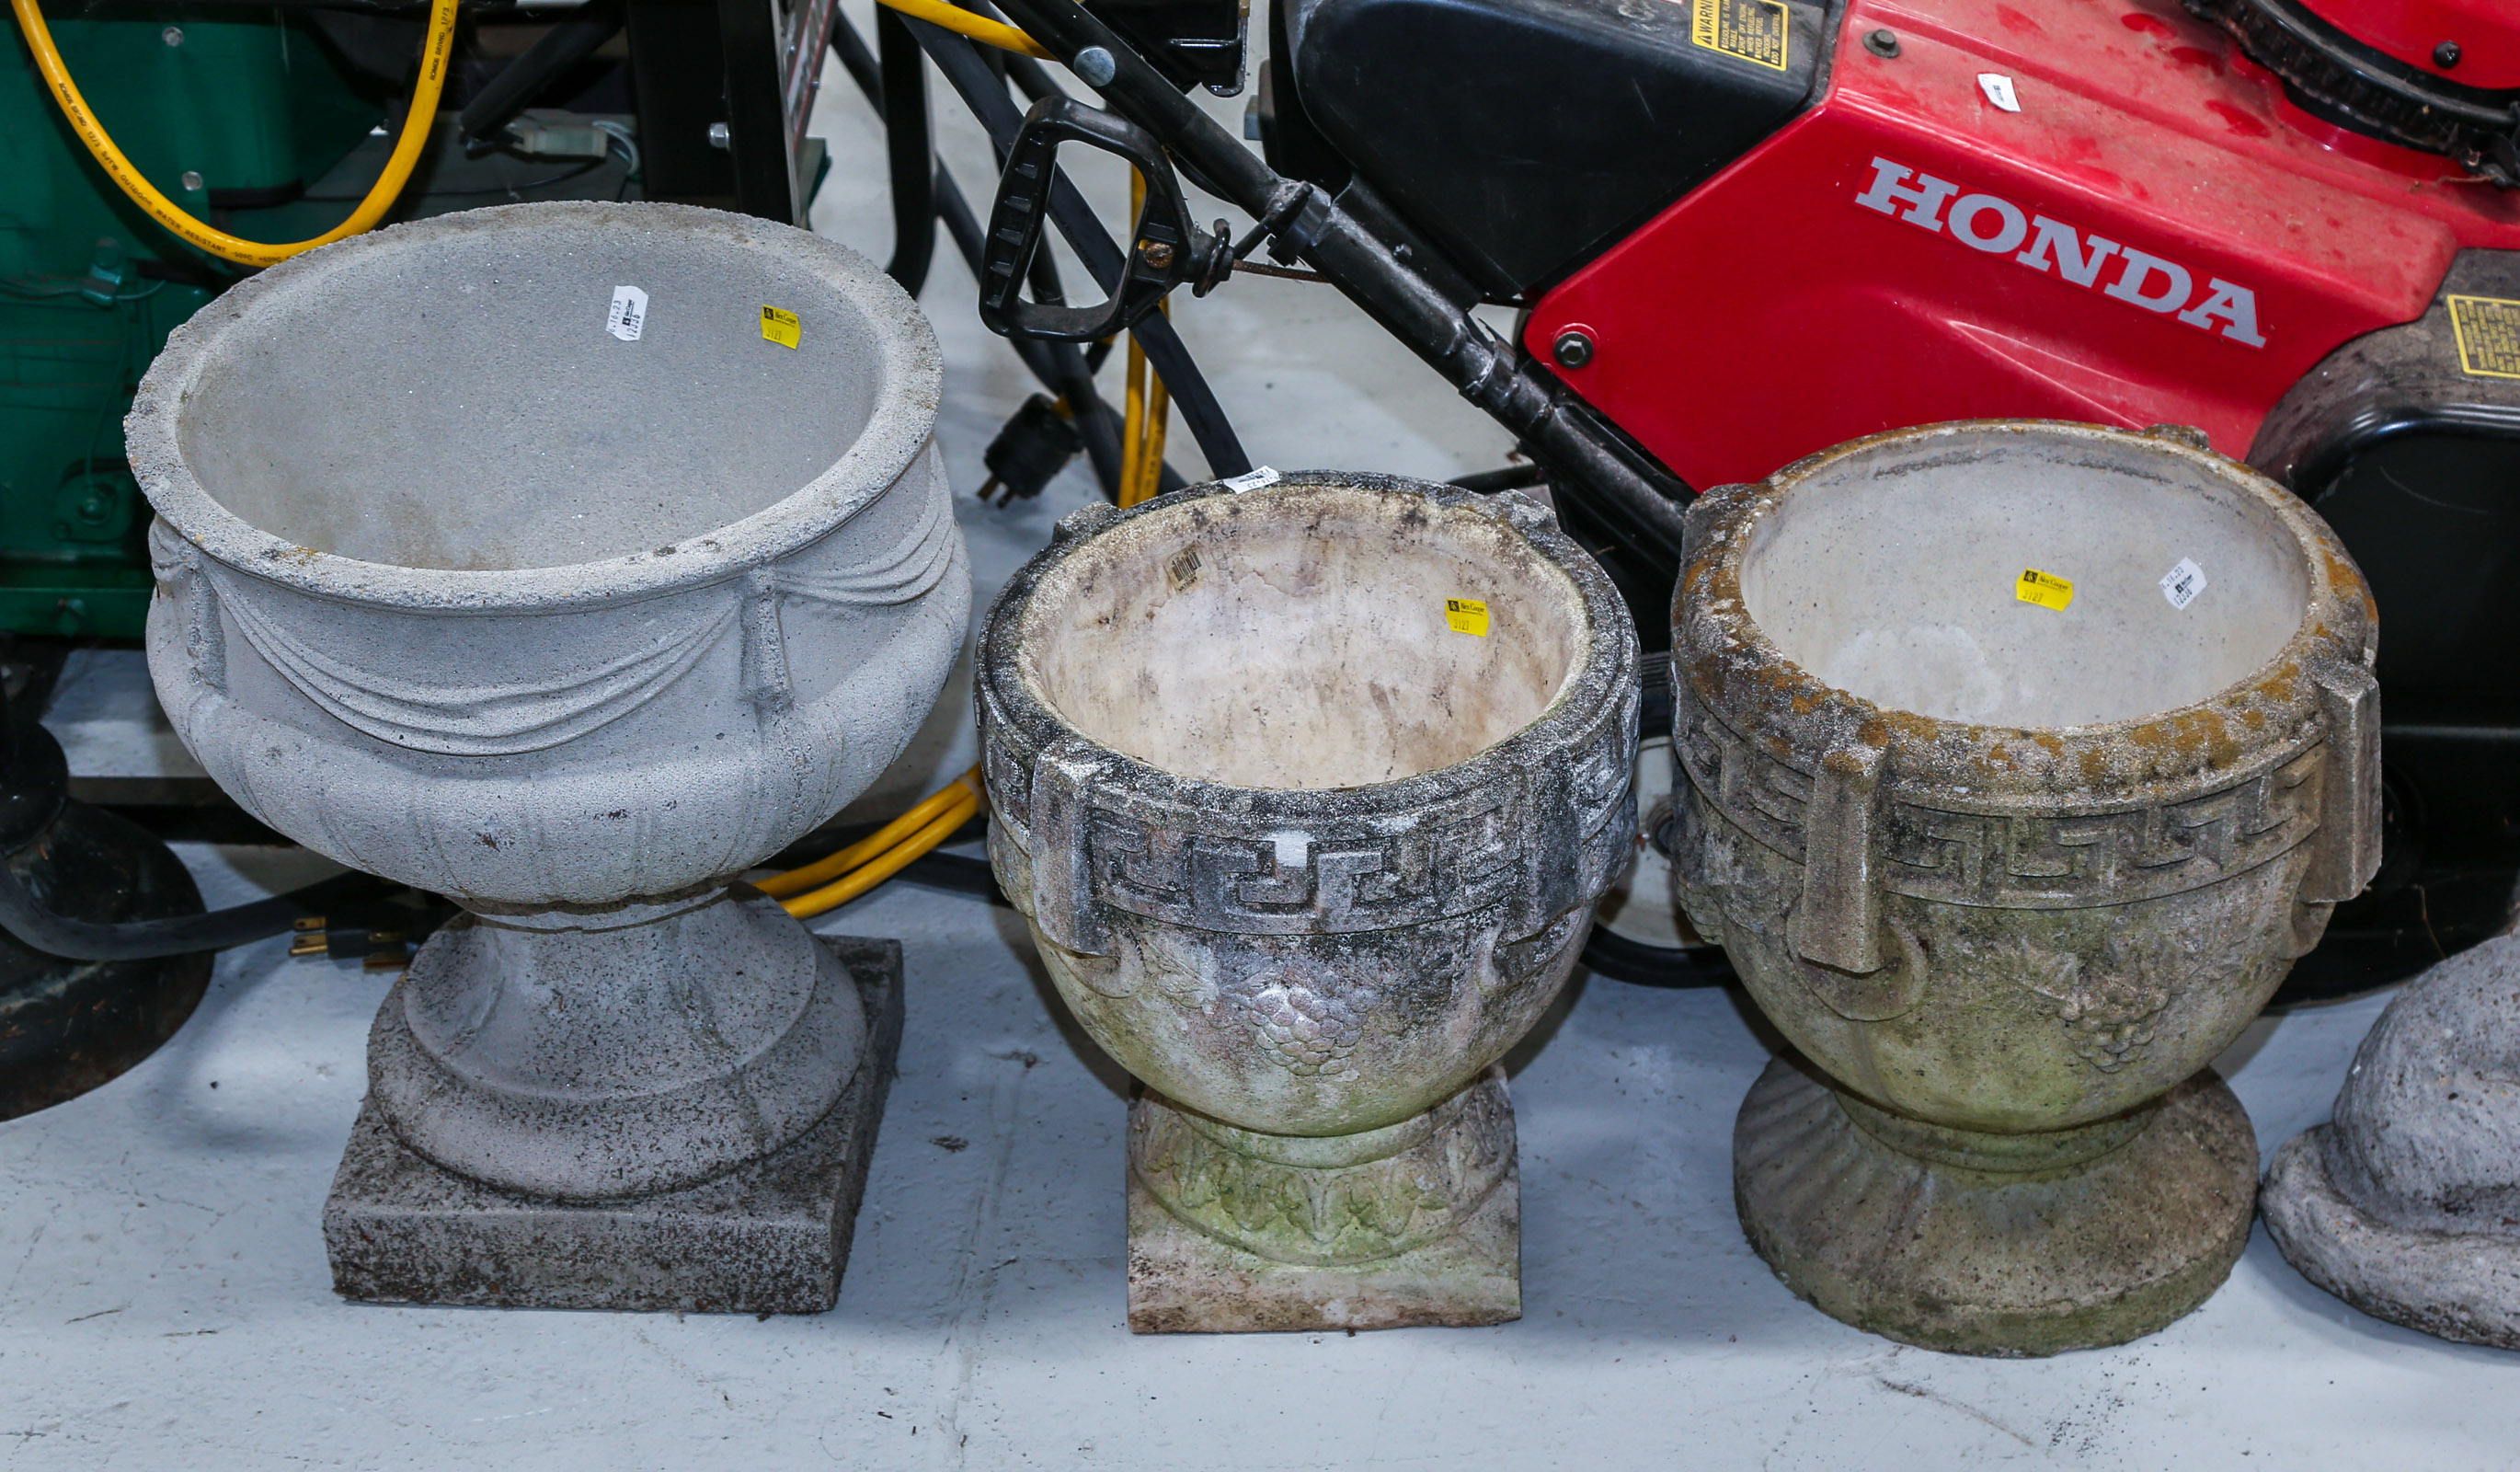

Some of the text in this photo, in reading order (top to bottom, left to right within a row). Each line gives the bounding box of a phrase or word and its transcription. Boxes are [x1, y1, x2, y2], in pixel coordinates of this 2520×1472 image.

[155, 209, 182, 230] WATER
[184, 230, 226, 253] RESISTANT
[1855, 155, 2266, 349] HONDA
